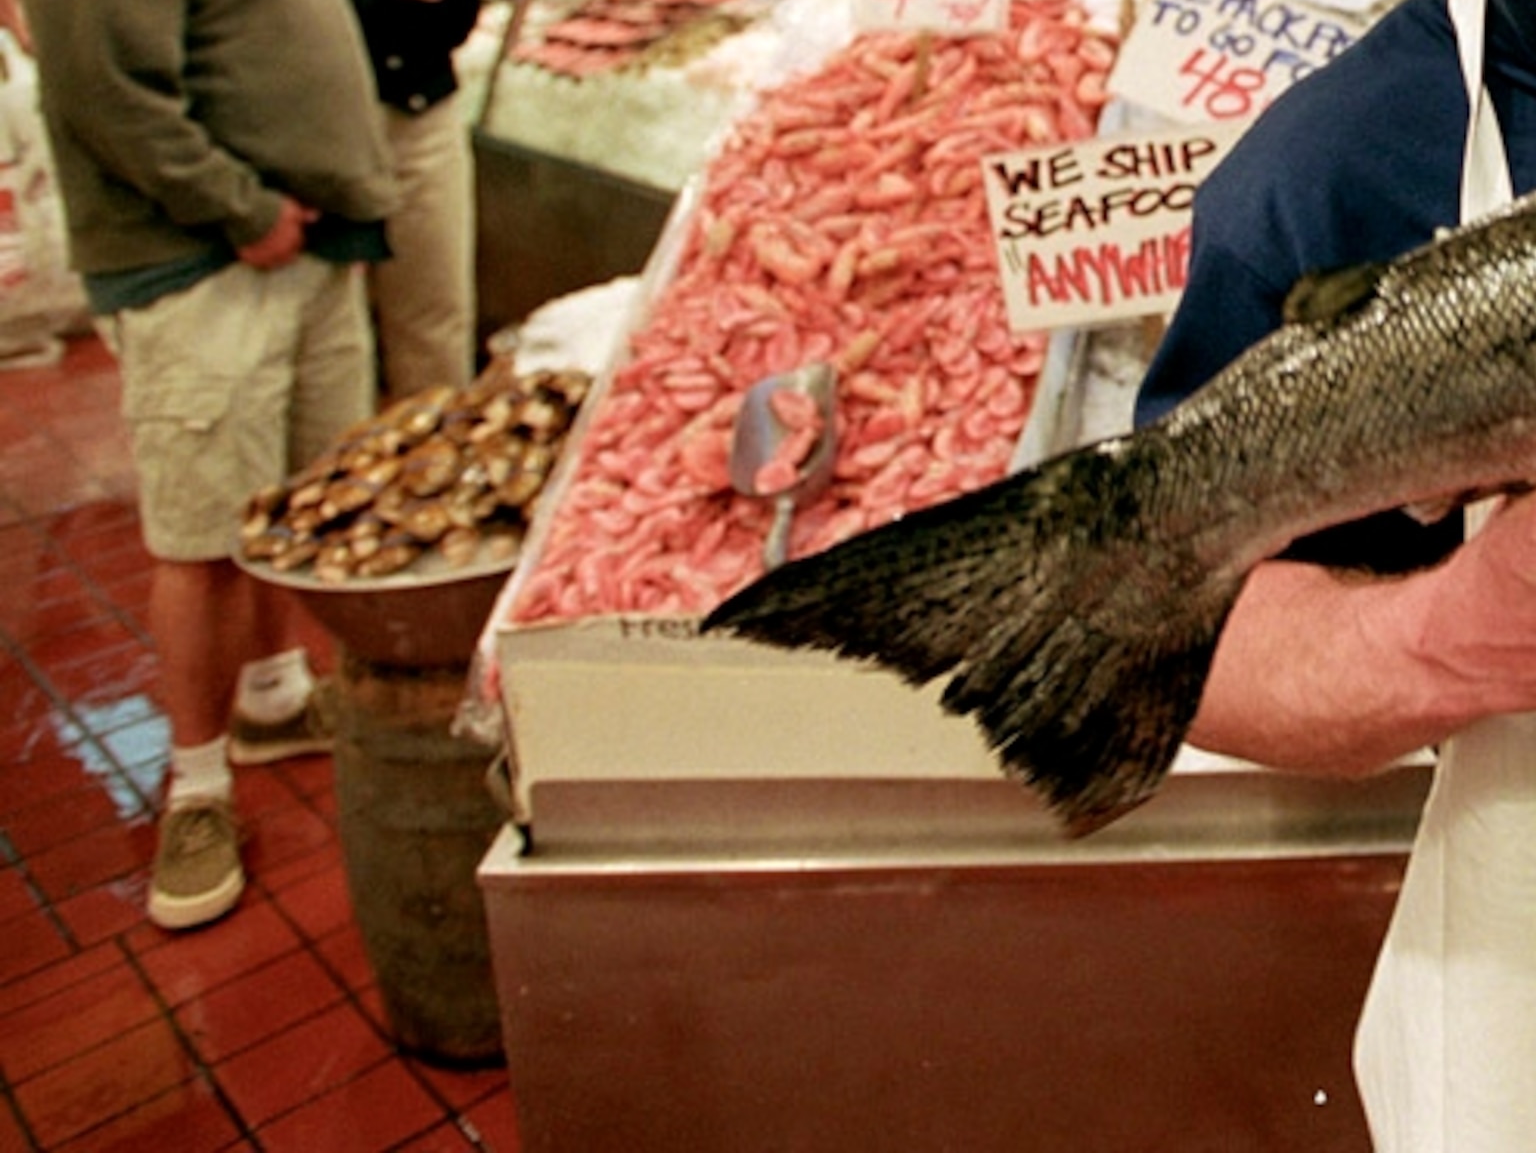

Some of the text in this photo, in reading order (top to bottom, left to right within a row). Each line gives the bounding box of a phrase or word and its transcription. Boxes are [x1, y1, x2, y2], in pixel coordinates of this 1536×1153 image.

[1179, 46, 1267, 120] 48
[1209, 23, 1255, 57] GO
[1262, 49, 1320, 84] FO
[991, 136, 1217, 197] WE SHIP
[1000, 183, 1196, 241] SEAFOO
[619, 617, 712, 640] Fres
